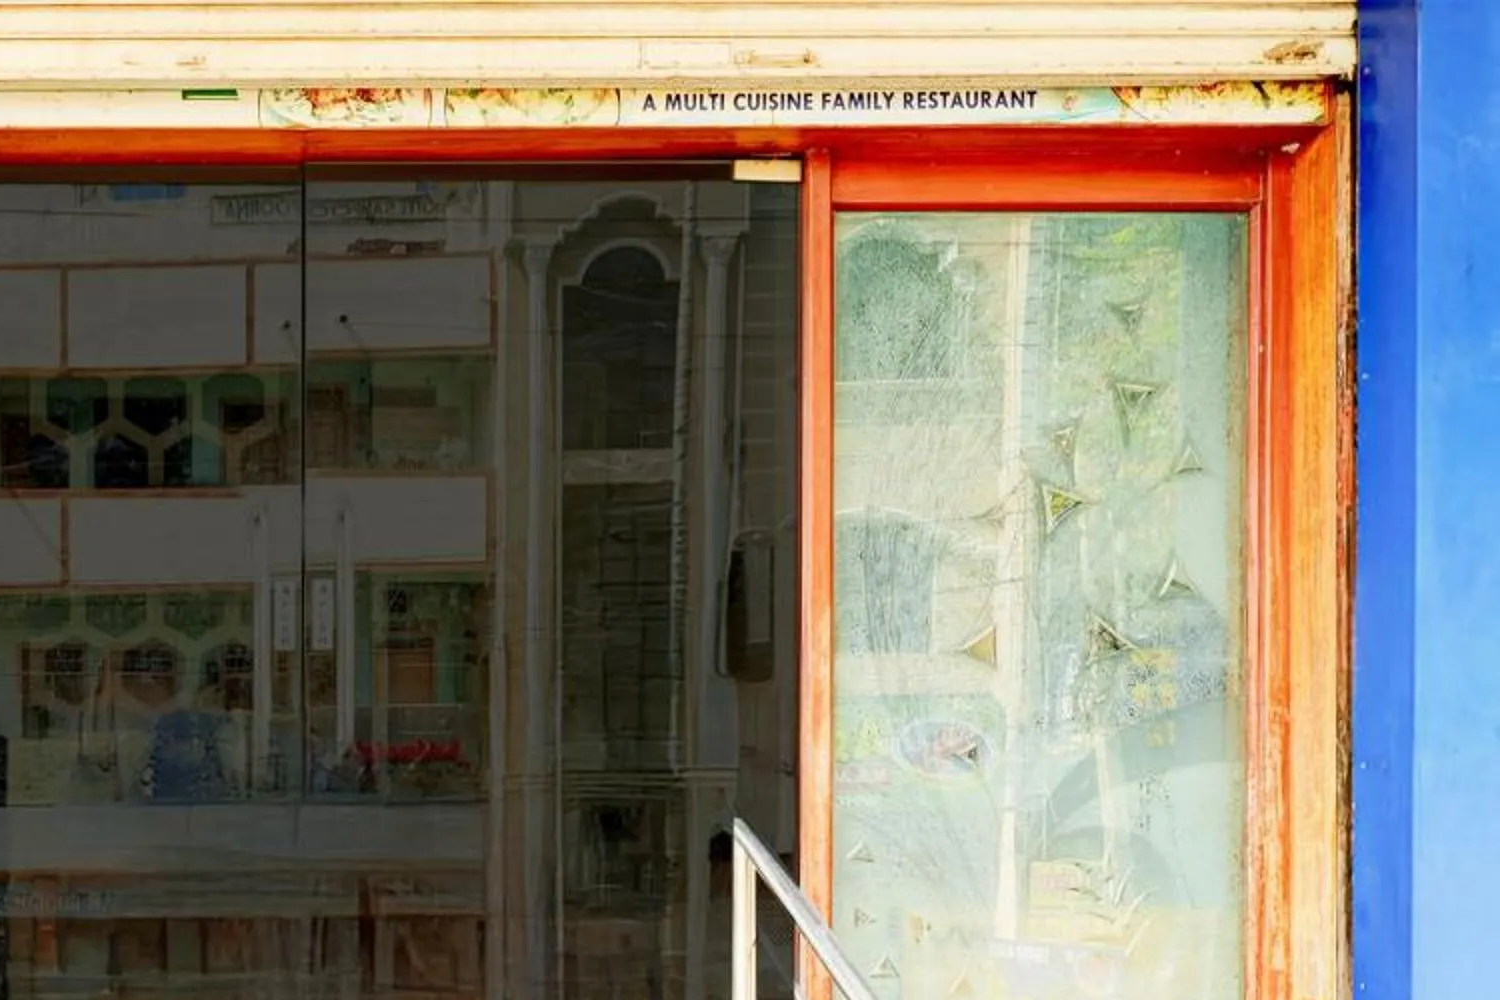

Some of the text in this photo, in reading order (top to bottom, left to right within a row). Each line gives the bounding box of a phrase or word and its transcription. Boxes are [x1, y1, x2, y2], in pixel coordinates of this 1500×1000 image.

[643, 90, 1038, 110] A MULTI CUISINE FAMILY RESTAURANT
